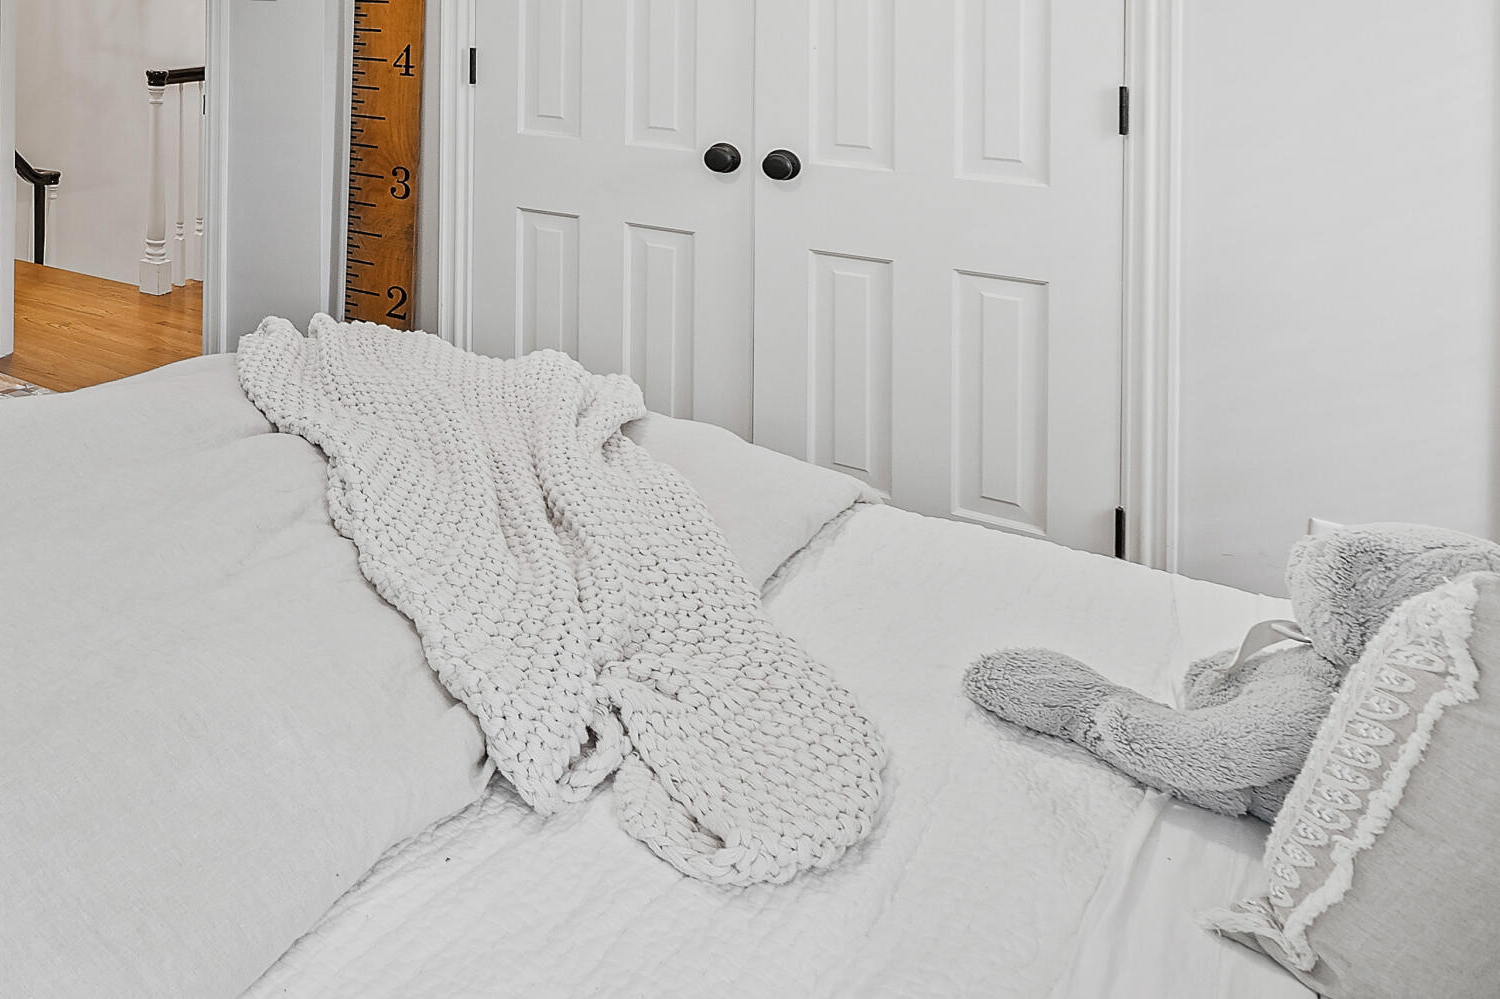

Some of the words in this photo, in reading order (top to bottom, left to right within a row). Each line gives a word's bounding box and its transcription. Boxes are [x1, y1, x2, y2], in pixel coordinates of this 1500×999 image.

[392, 45, 416, 78] 4
[390, 166, 412, 200] 3
[386, 286, 408, 321] 2
